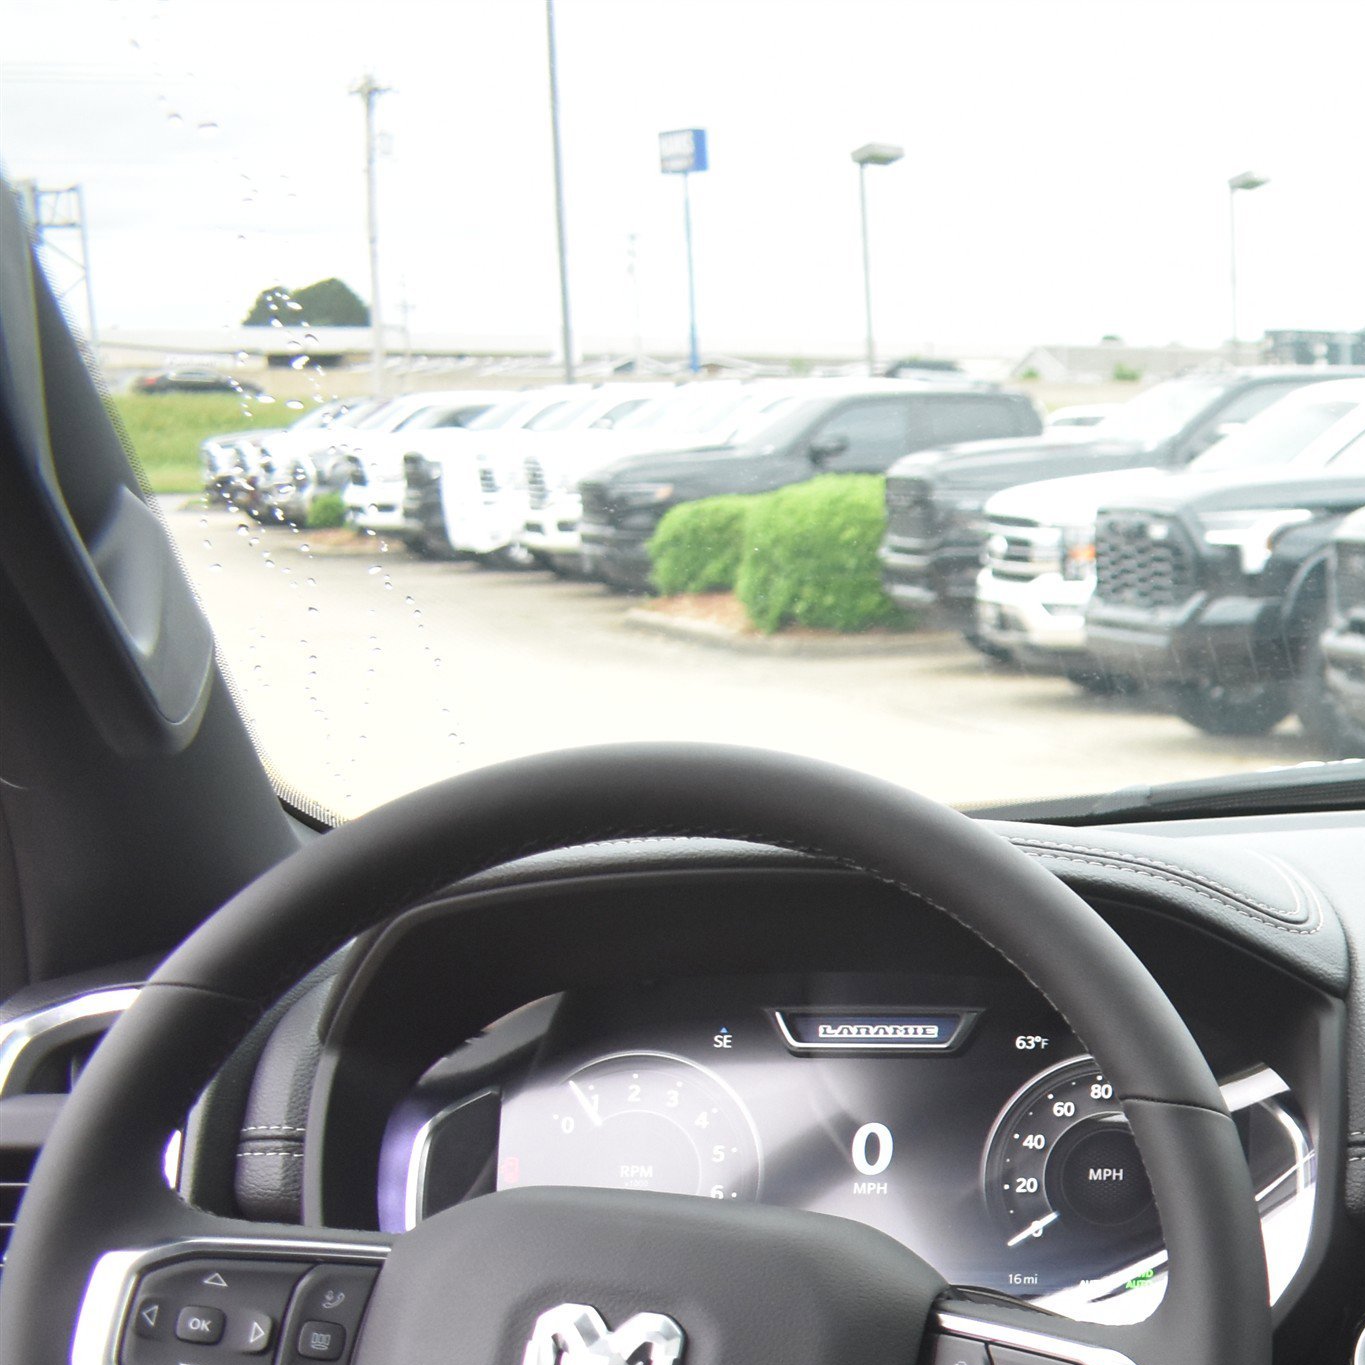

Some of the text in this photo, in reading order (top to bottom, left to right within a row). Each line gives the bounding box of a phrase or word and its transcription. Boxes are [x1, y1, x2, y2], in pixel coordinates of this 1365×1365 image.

[713, 1035, 732, 1048] SE
[627, 1084, 641, 1102] 2
[1090, 1084, 1112, 1099] 80
[666, 1090, 679, 1108] 3
[1053, 1102, 1075, 1116] 60
[561, 1116, 575, 1134] 0
[694, 1112, 709, 1129] 4
[852, 1122, 893, 1176] 0
[1023, 1135, 1045, 1149] 40
[712, 1145, 725, 1162] 5
[620, 1165, 653, 1178] RPM
[1089, 1169, 1124, 1180] MPH
[853, 1182, 888, 1194] MPH
[1015, 1178, 1038, 1192] 20
[1008, 1273, 1038, 1284] 16 mi
[189, 1317, 211, 1332] OK
